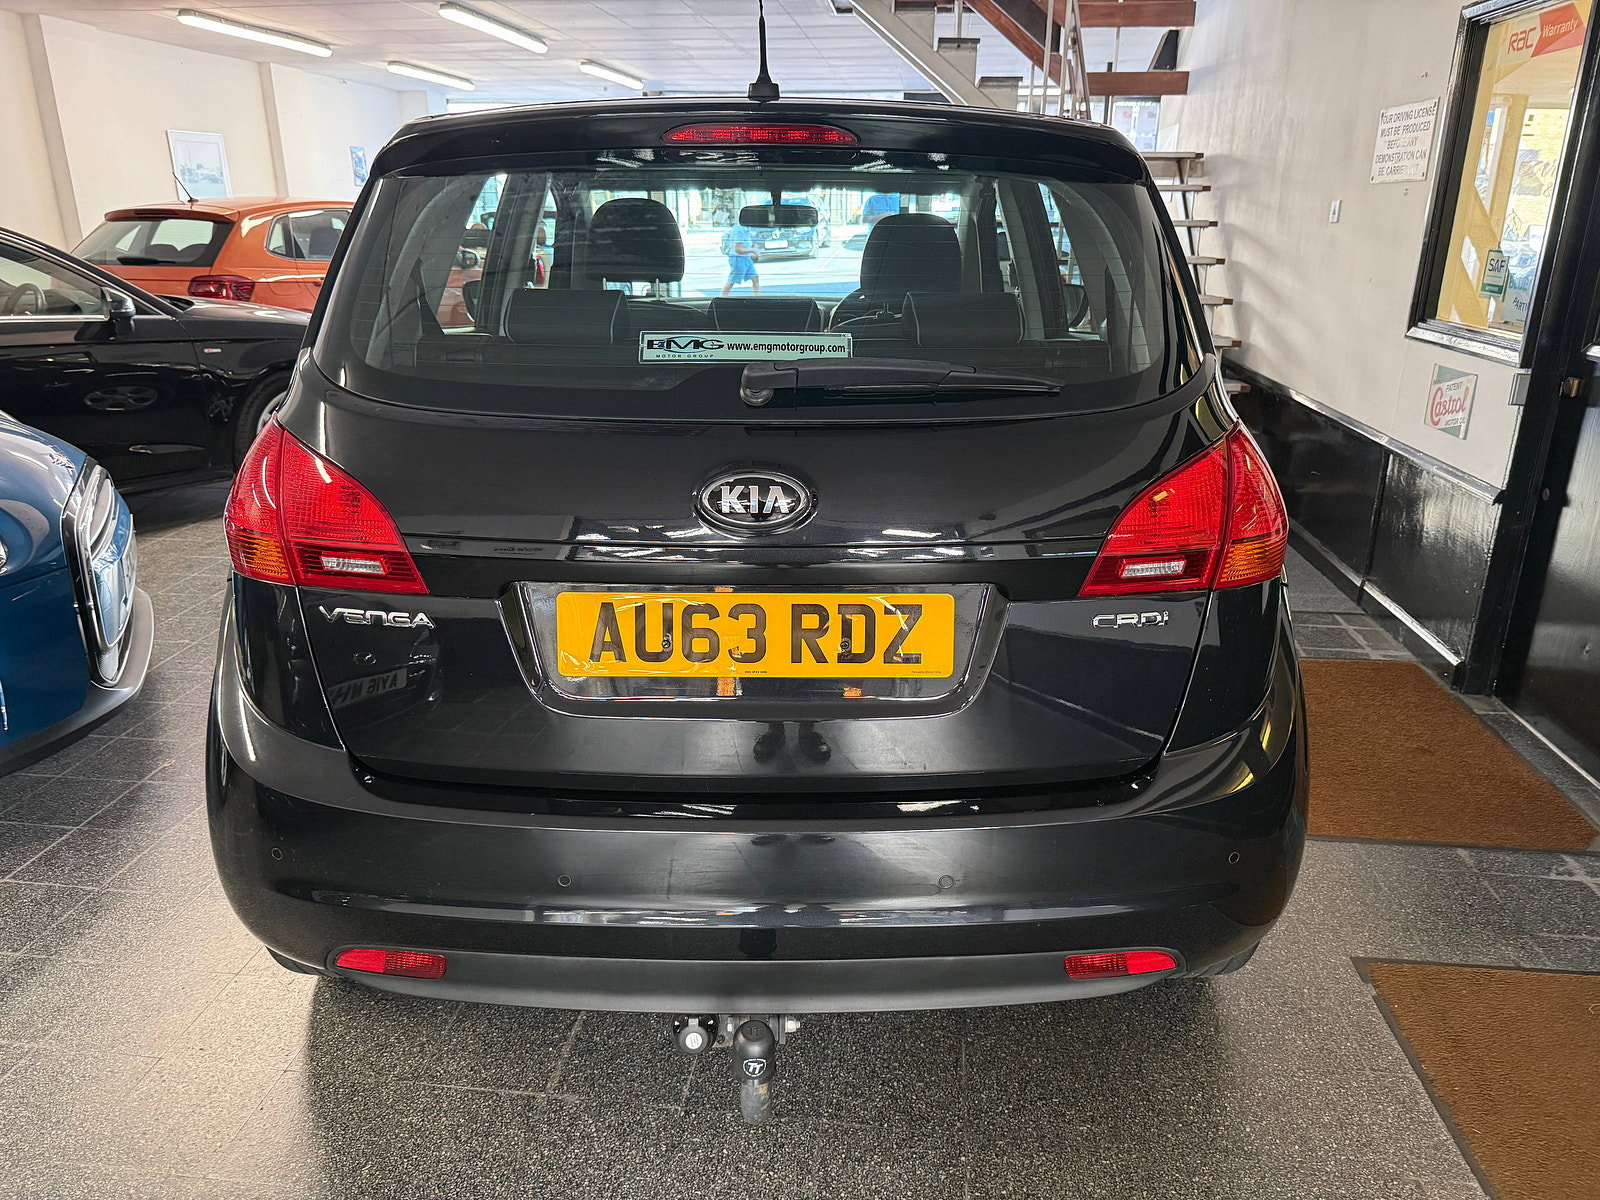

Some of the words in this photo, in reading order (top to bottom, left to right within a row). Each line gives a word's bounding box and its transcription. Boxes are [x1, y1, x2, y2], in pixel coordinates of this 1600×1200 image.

[1542, 17, 1579, 37] Warranty
[1393, 110, 1414, 123] DRIVING
[1414, 105, 1437, 119] LICENSE
[1380, 126, 1393, 137] MUST
[1393, 125, 1401, 136] BE
[1402, 121, 1430, 134] PRODUCED
[1375, 150, 1415, 164] DEMONSTRATION
[1415, 149, 1427, 160] CAN
[1378, 166, 1385, 176] BE
[647, 339, 725, 350] EMG
[727, 341, 846, 354] www.emgmotorgroup.com
[1430, 386, 1469, 426] Castrol
[720, 485, 790, 514] KIA
[319, 605, 435, 629] VENGA
[588, 602, 768, 664] AU63
[790, 603, 923, 664] RDZ
